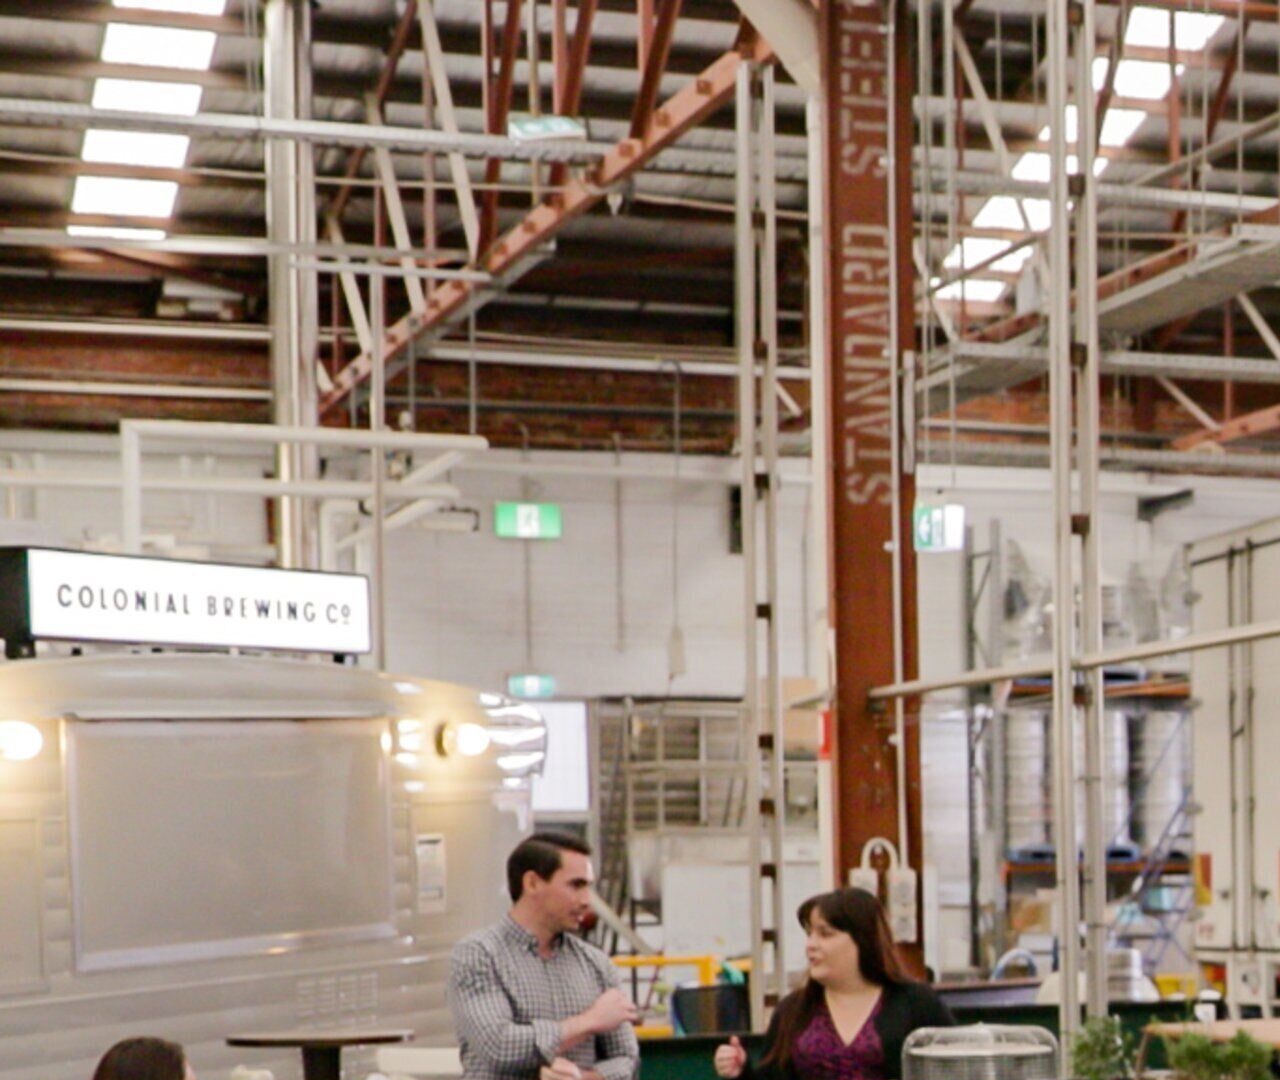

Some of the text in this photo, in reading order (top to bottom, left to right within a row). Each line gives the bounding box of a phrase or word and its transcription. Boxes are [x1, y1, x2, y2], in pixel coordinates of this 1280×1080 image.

[842, 224, 892, 505] STANDARD
[57, 584, 190, 615] COLONIAL
[207, 595, 317, 623] BREWING
